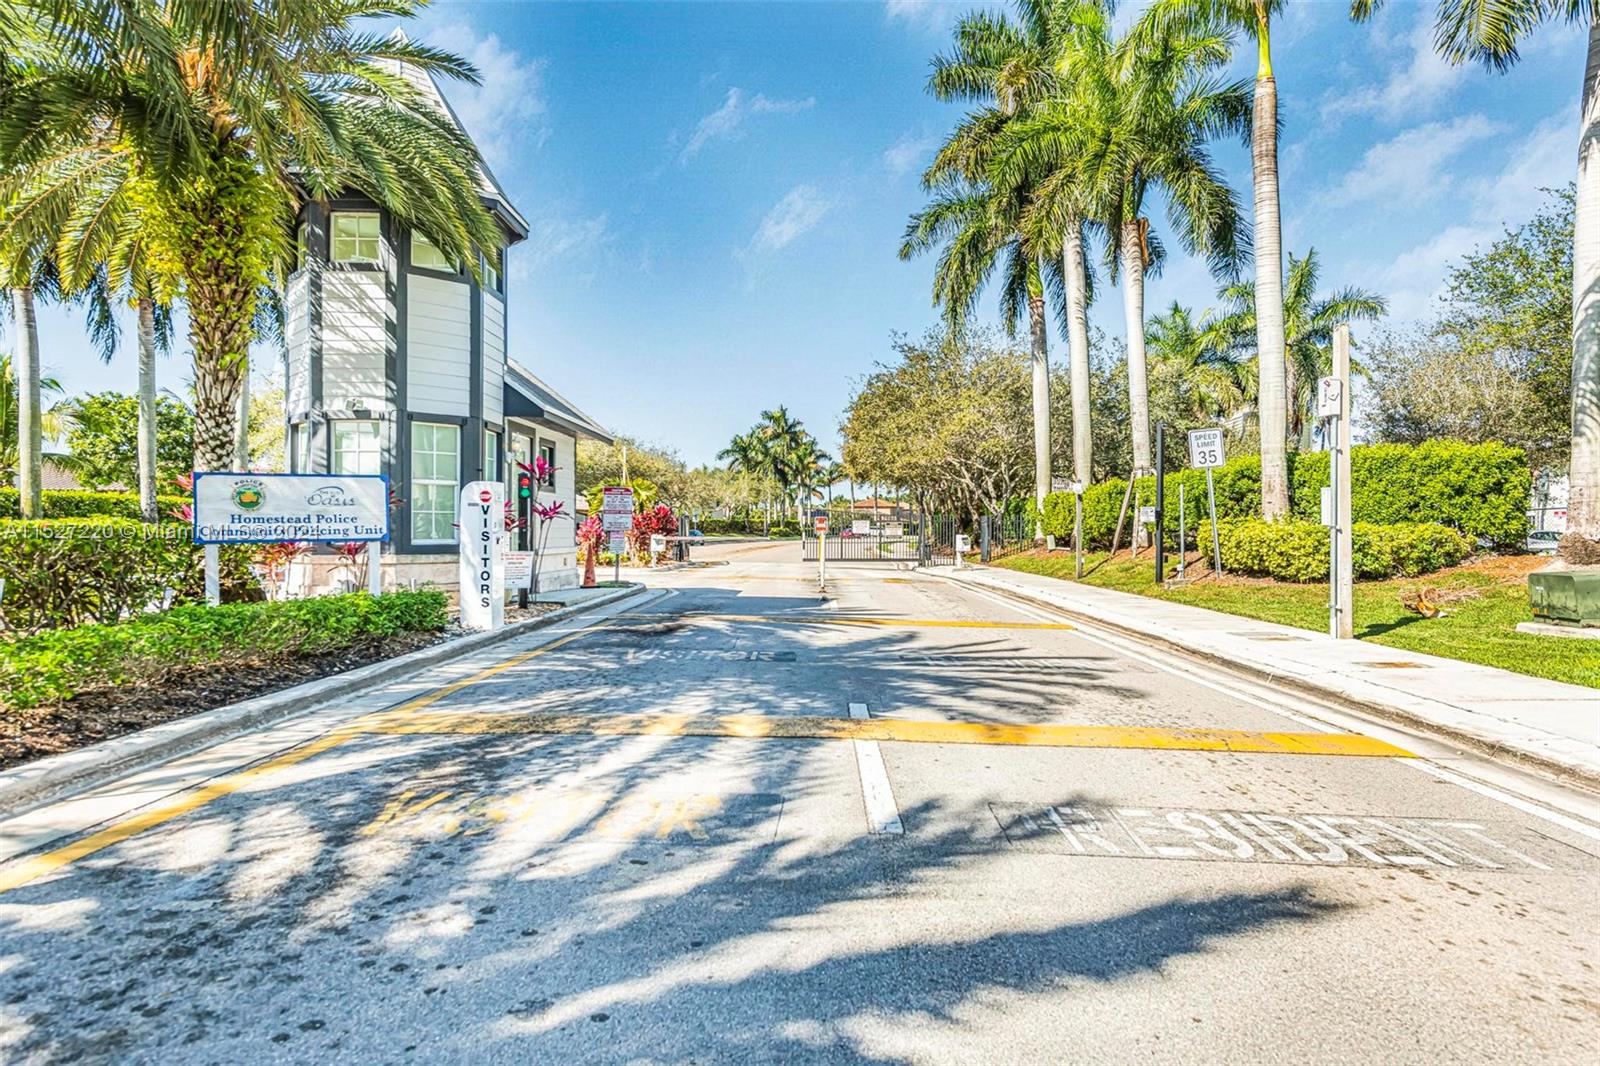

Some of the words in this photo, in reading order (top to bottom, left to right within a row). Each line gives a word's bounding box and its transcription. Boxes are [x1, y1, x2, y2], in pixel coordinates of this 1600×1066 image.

[1194, 433, 1218, 441] SPEED
[1198, 450, 1217, 464] 35
[230, 514, 312, 525] Homestead
[316, 514, 358, 525] Police
[354, 525, 385, 535] Unit
[481, 505, 491, 608] VISITORS
[1046, 805, 1553, 870] RESIDENT
